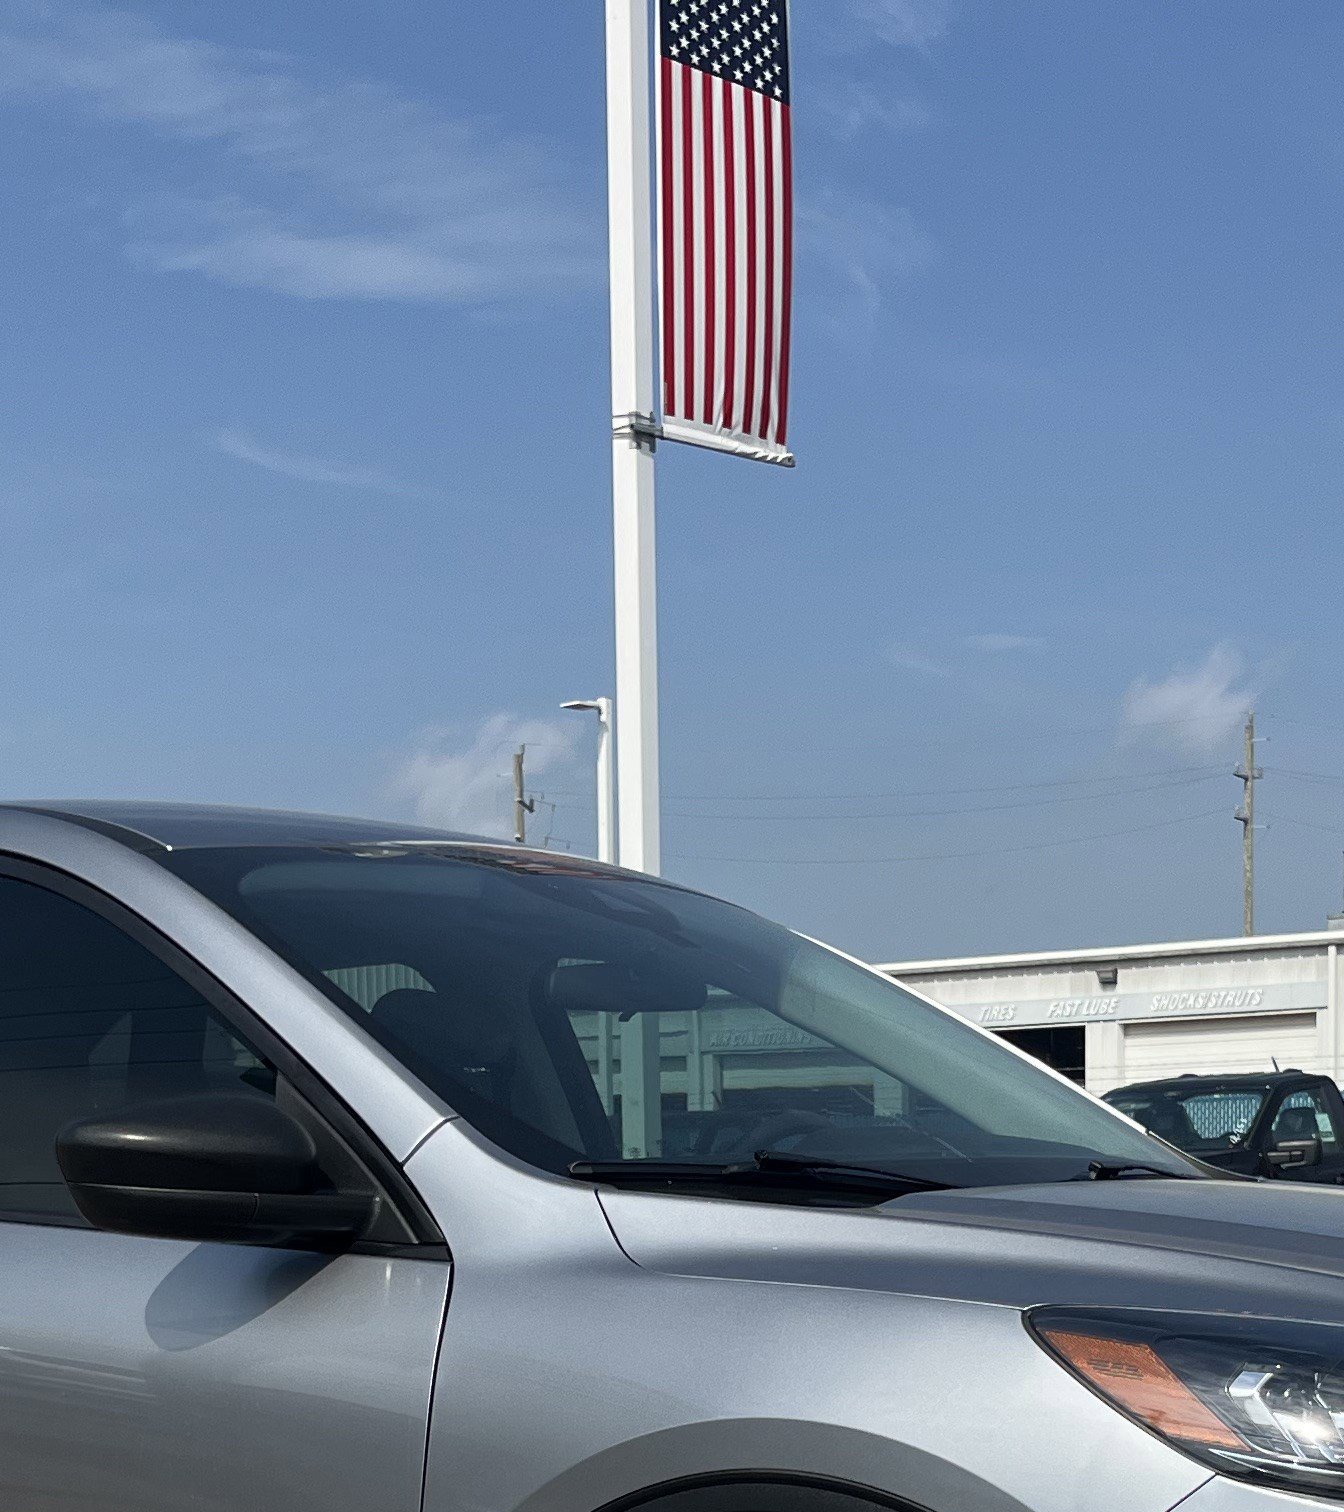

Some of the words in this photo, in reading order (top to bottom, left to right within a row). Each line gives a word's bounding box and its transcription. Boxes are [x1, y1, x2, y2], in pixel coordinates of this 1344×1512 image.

[980, 1003, 1017, 1022] TIRES
[1047, 1000, 1082, 1018] FAST
[1082, 998, 1119, 1016] LUBE
